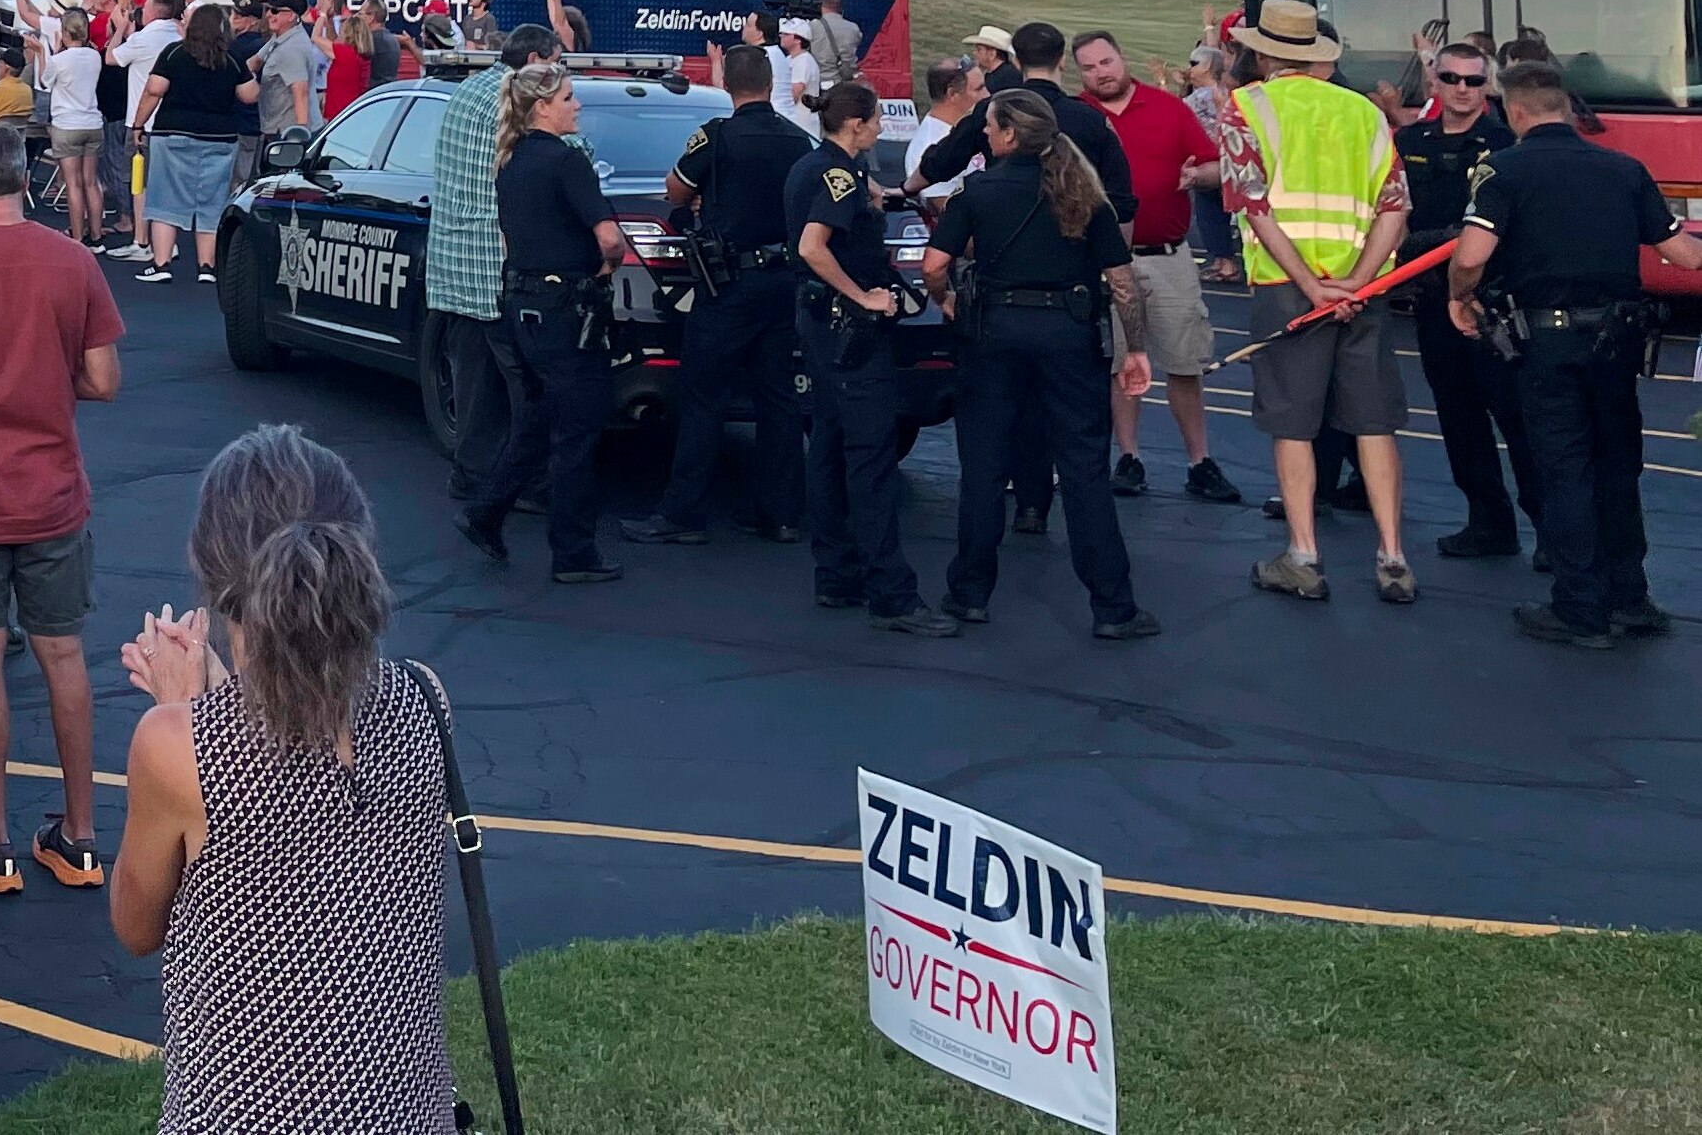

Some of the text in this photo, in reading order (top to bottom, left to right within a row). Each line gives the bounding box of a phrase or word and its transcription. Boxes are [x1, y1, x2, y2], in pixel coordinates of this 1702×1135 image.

[635, 8, 748, 32] ZeldinForNe
[880, 103, 914, 117] LDIN
[320, 219, 398, 249] MONROE COUNTY
[301, 237, 411, 309] SHERIFF
[868, 792, 1093, 962] ZELDIN
[870, 925, 1099, 1074] GOVERNOR
